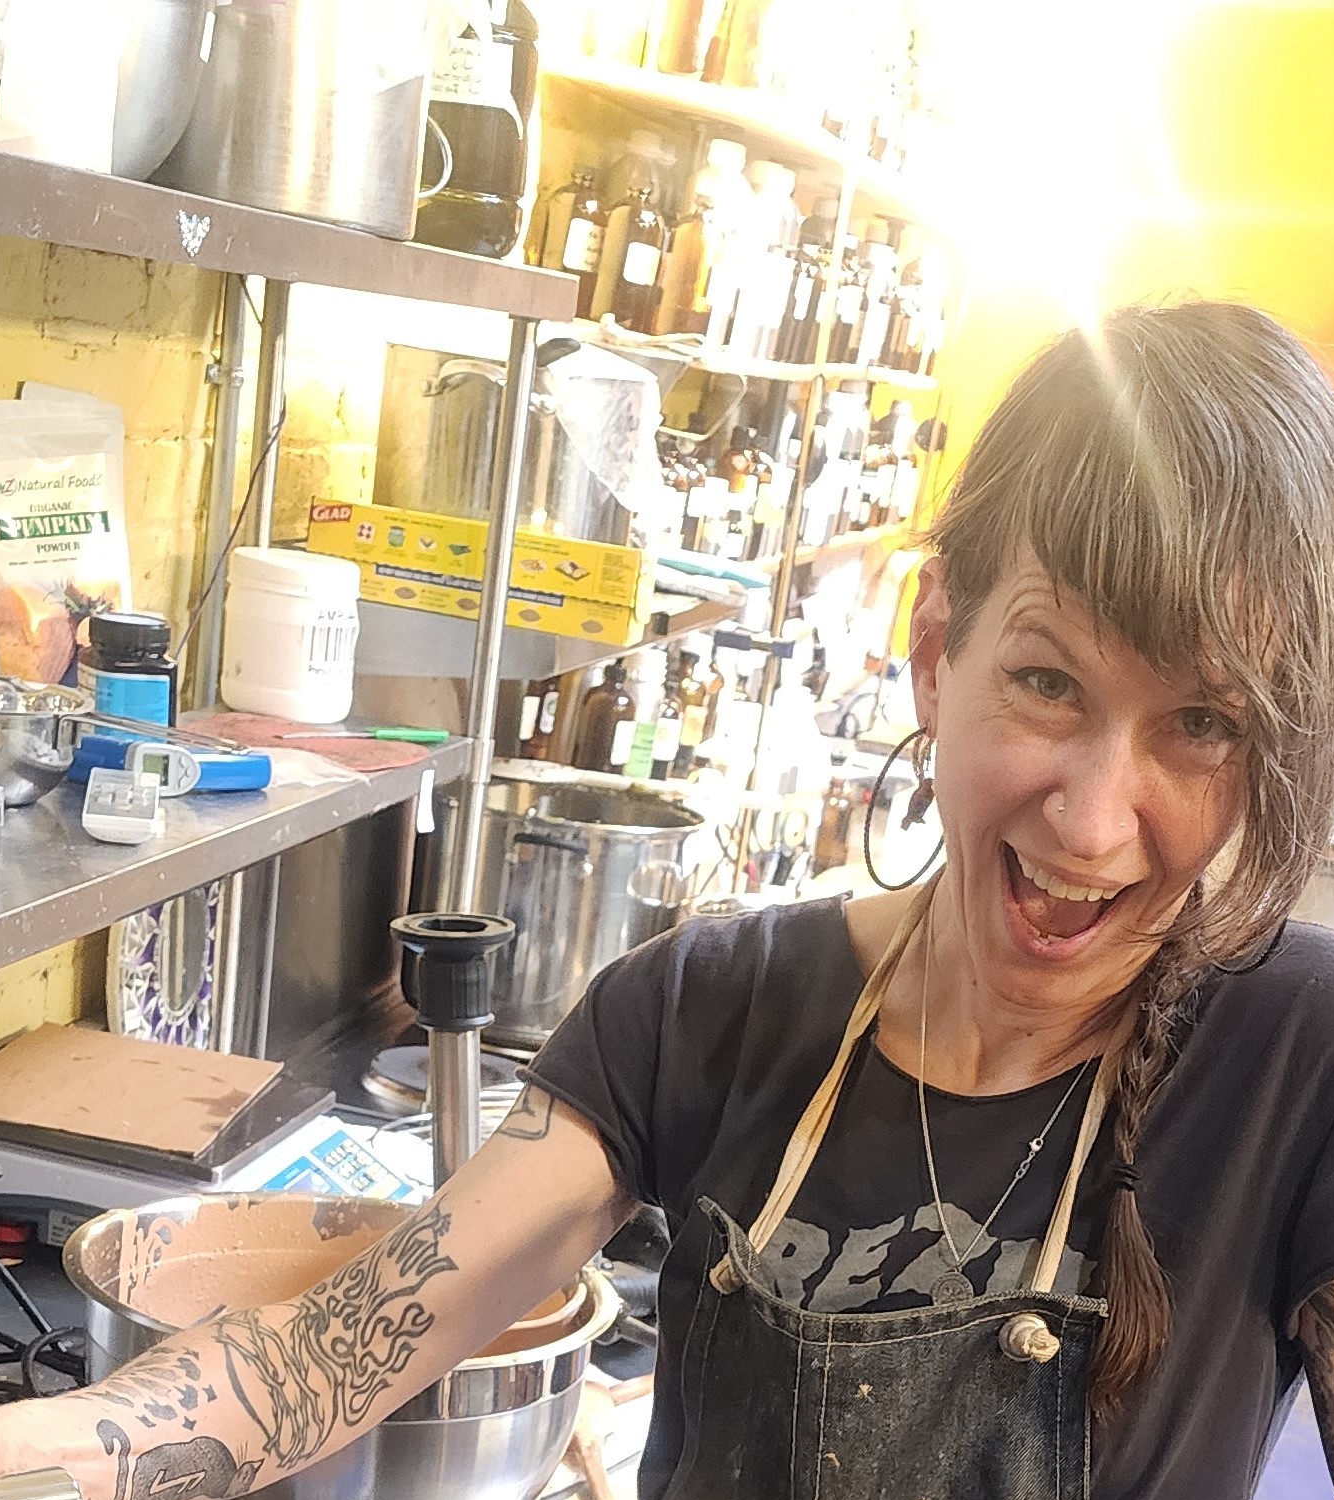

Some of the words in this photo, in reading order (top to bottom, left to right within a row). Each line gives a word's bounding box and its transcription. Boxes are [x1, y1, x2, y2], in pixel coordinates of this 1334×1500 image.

[18, 475, 65, 492] Natural
[311, 505, 352, 521] GLAD
[36, 541, 81, 554] POWDER
